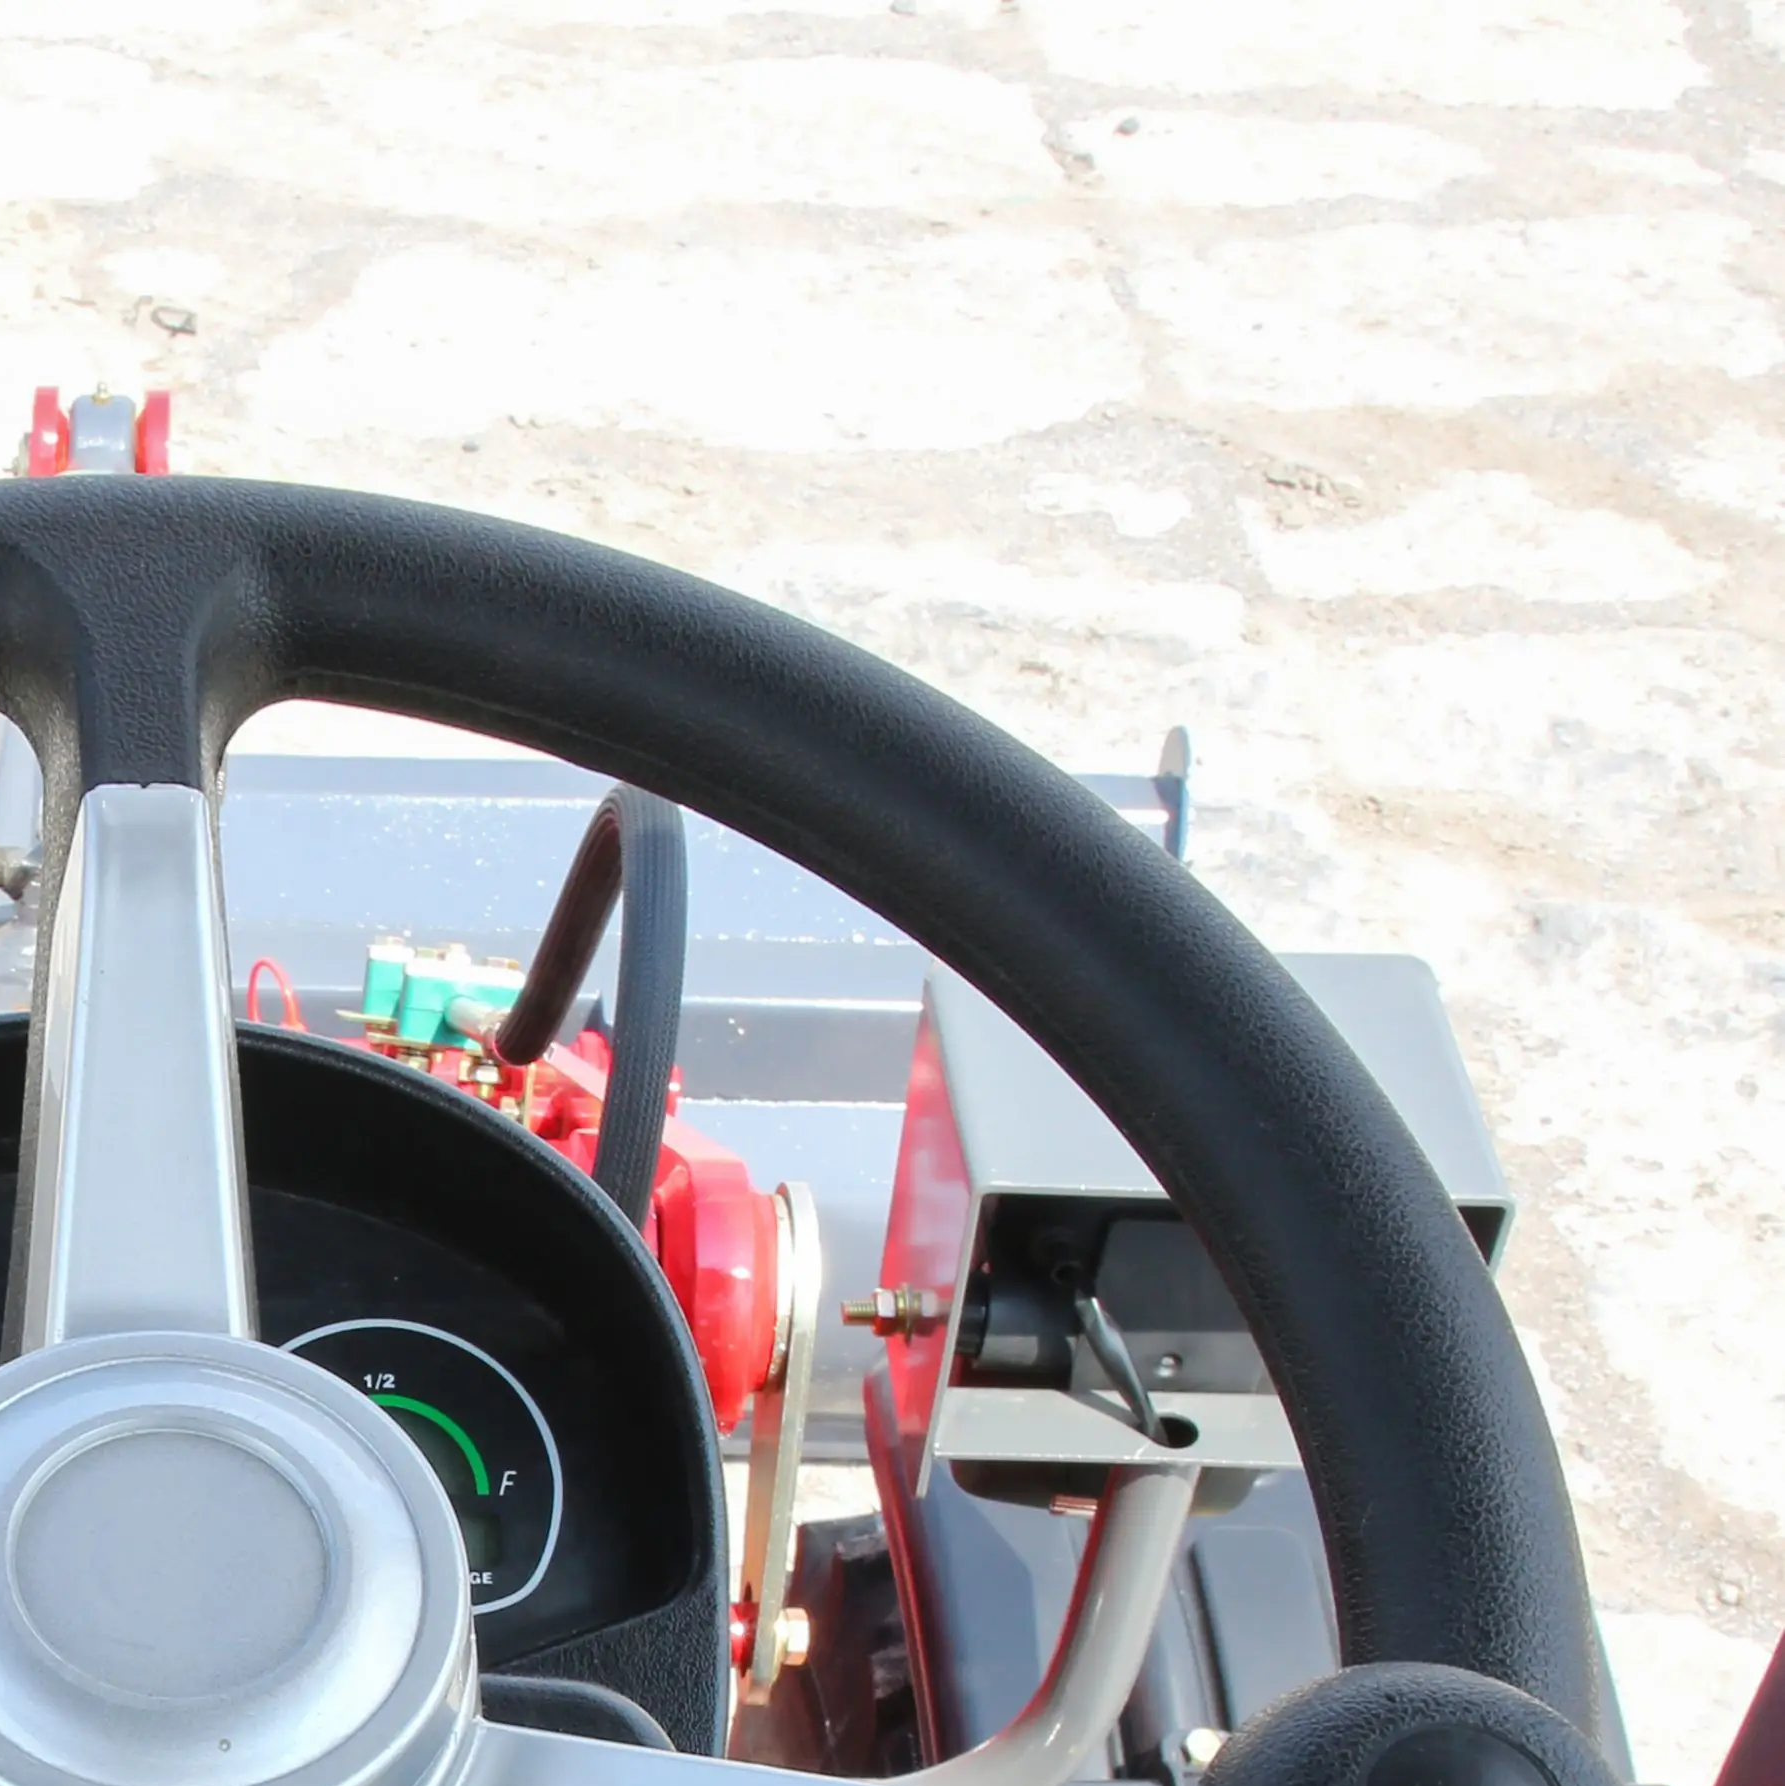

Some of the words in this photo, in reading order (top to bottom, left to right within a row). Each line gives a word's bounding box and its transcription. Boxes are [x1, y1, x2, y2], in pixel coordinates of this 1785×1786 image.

[363, 1373, 396, 1390] 1/2
[499, 1470, 517, 1496] F
[469, 1571, 494, 1585] GE
